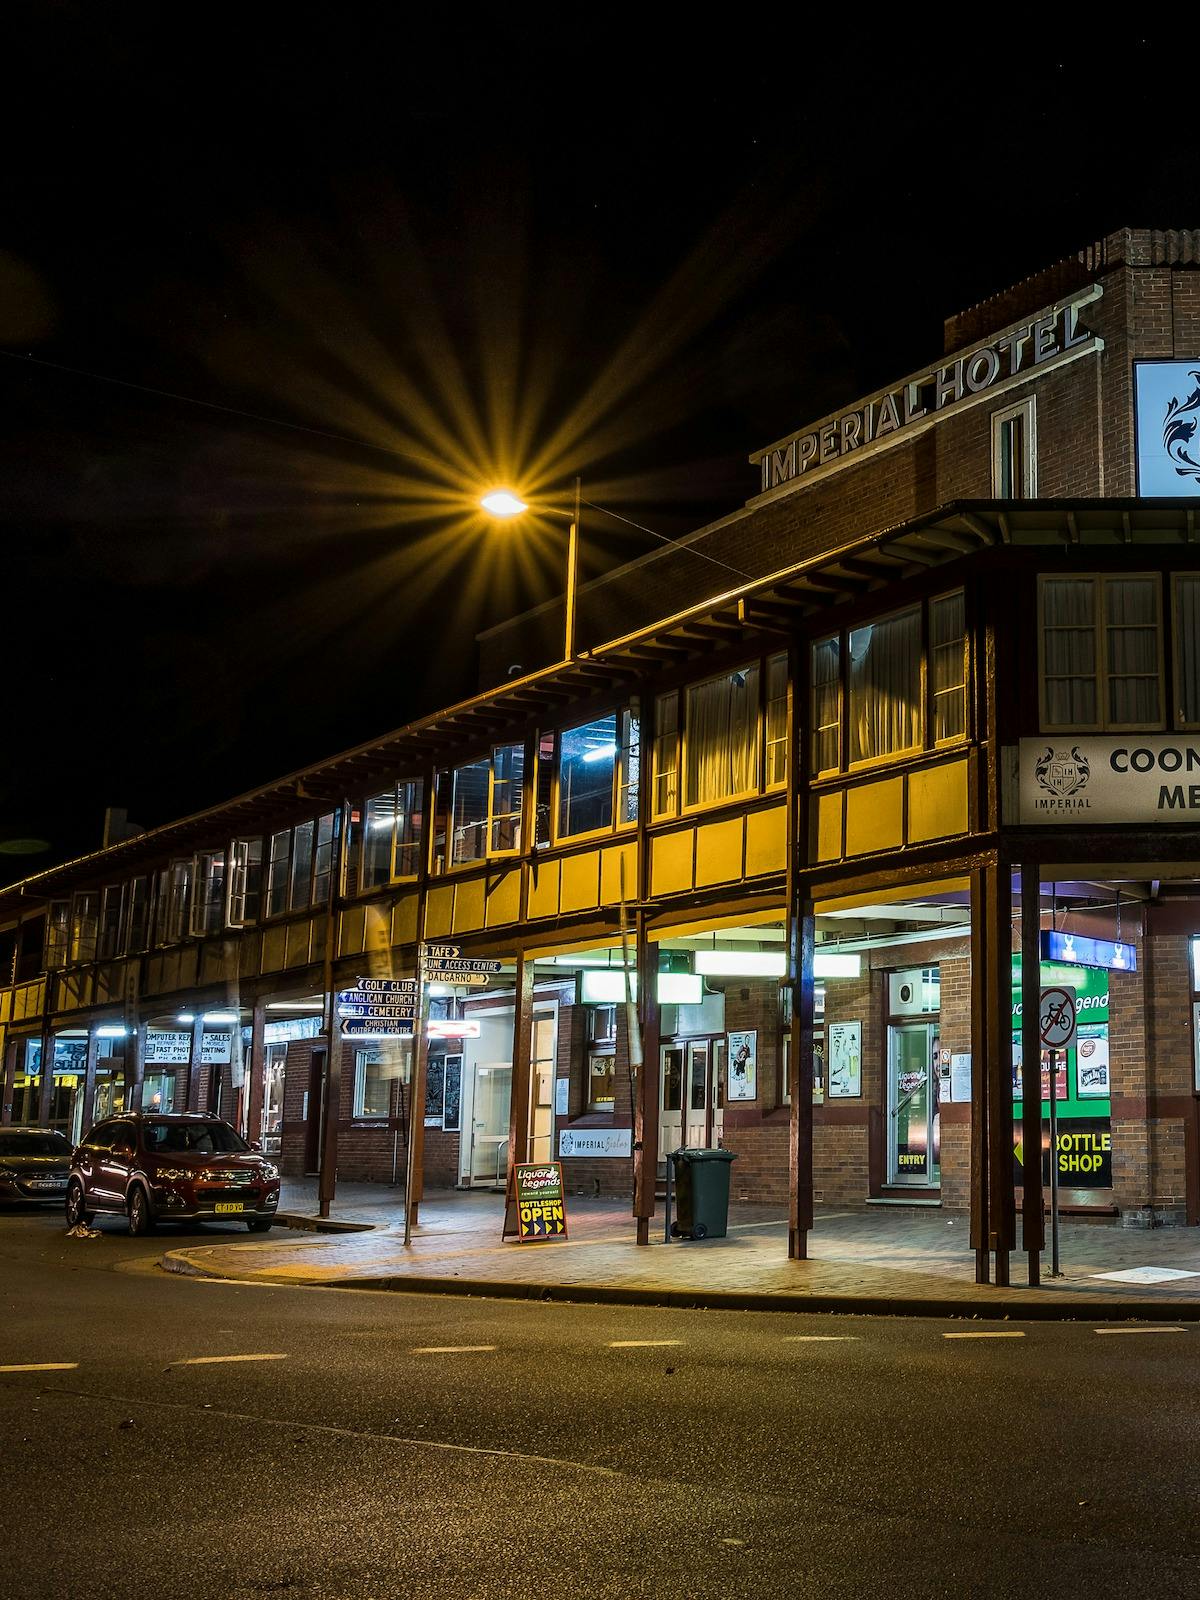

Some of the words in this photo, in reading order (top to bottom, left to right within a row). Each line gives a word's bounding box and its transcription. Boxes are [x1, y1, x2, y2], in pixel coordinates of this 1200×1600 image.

[762, 384, 927, 492] IMPERIAL
[934, 306, 1091, 410] HOTEL
[1035, 799, 1091, 808] IMPERIAL
[431, 946, 450, 957] TAFE
[429, 959, 442, 969] UNE
[445, 959, 471, 971] ACCESS
[473, 961, 498, 971] CENTRE
[429, 972, 471, 983] DALGARNO
[365, 981, 387, 990] GOLF
[391, 982, 413, 991] CLUB
[349, 993, 383, 1003] ANGLICAN
[385, 995, 412, 1004] CHURCH
[368, 1007, 411, 1017] CEMETERY
[210, 1034, 231, 1042] SALES
[898, 1155, 925, 1164] ENTRY
[1060, 1154, 1103, 1172] SHOP
[518, 1169, 547, 1181] Liquor
[522, 1177, 560, 1189] Legends
[520, 1200, 562, 1208] BOTTLESHOP
[521, 1207, 563, 1222] OPEN
